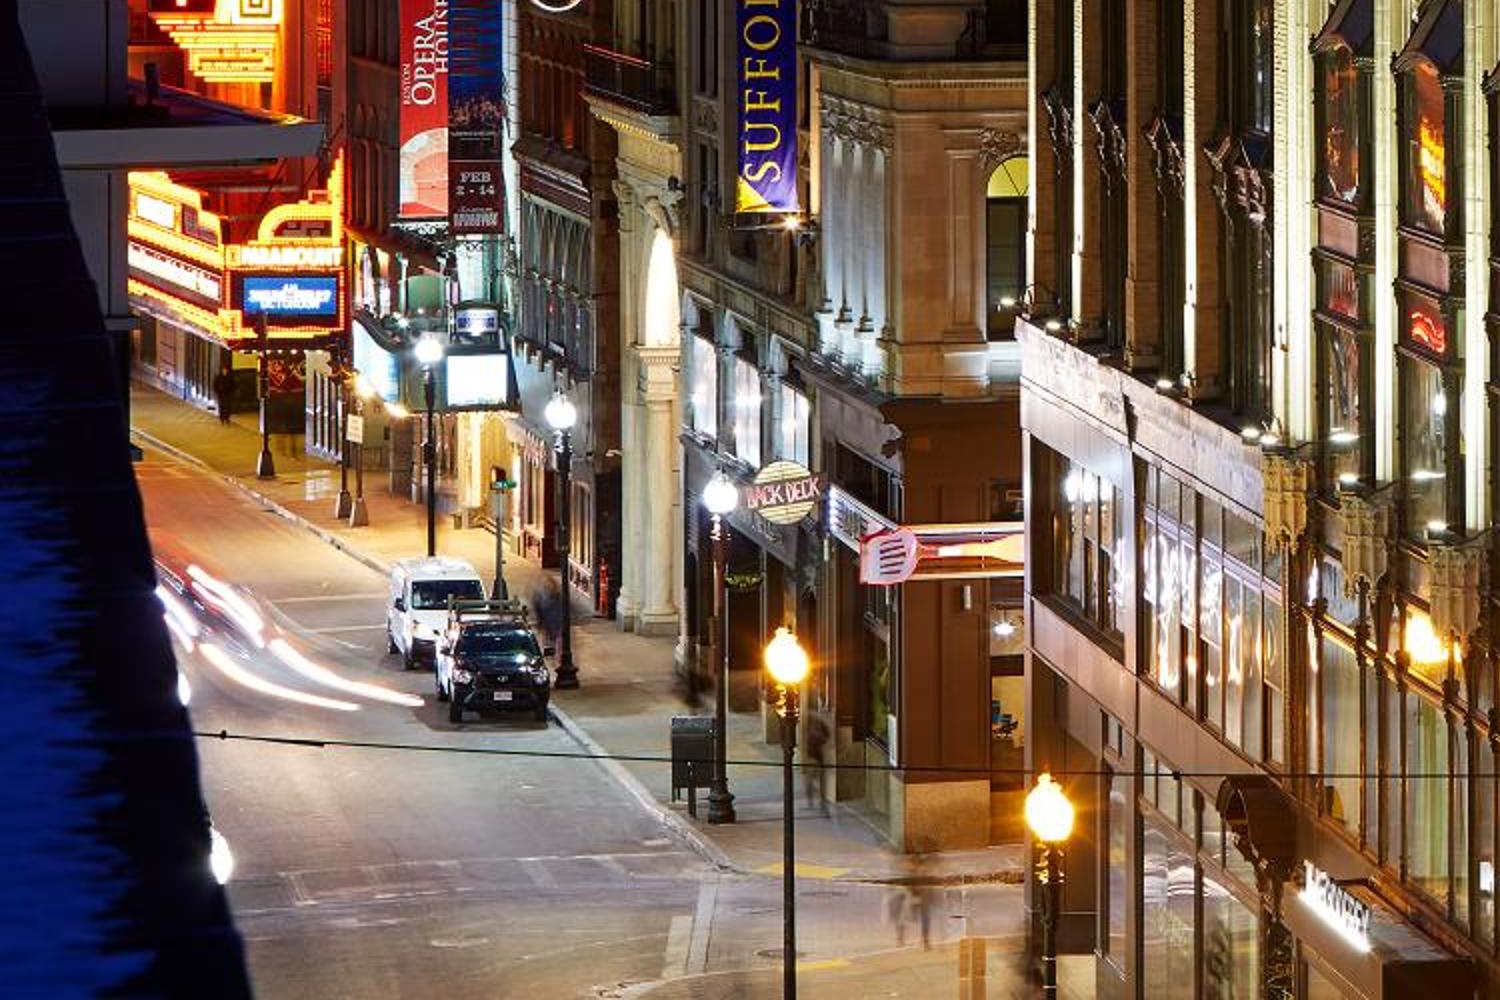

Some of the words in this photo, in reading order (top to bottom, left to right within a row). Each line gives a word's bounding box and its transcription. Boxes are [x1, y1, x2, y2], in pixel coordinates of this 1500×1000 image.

[411, 15, 435, 105] OPERA
[461, 171, 491, 182] FEB
[480, 184, 495, 195] 14
[241, 247, 344, 266] PARAMOUNT
[745, 484, 785, 509] BACK
[786, 476, 821, 503] DECK
